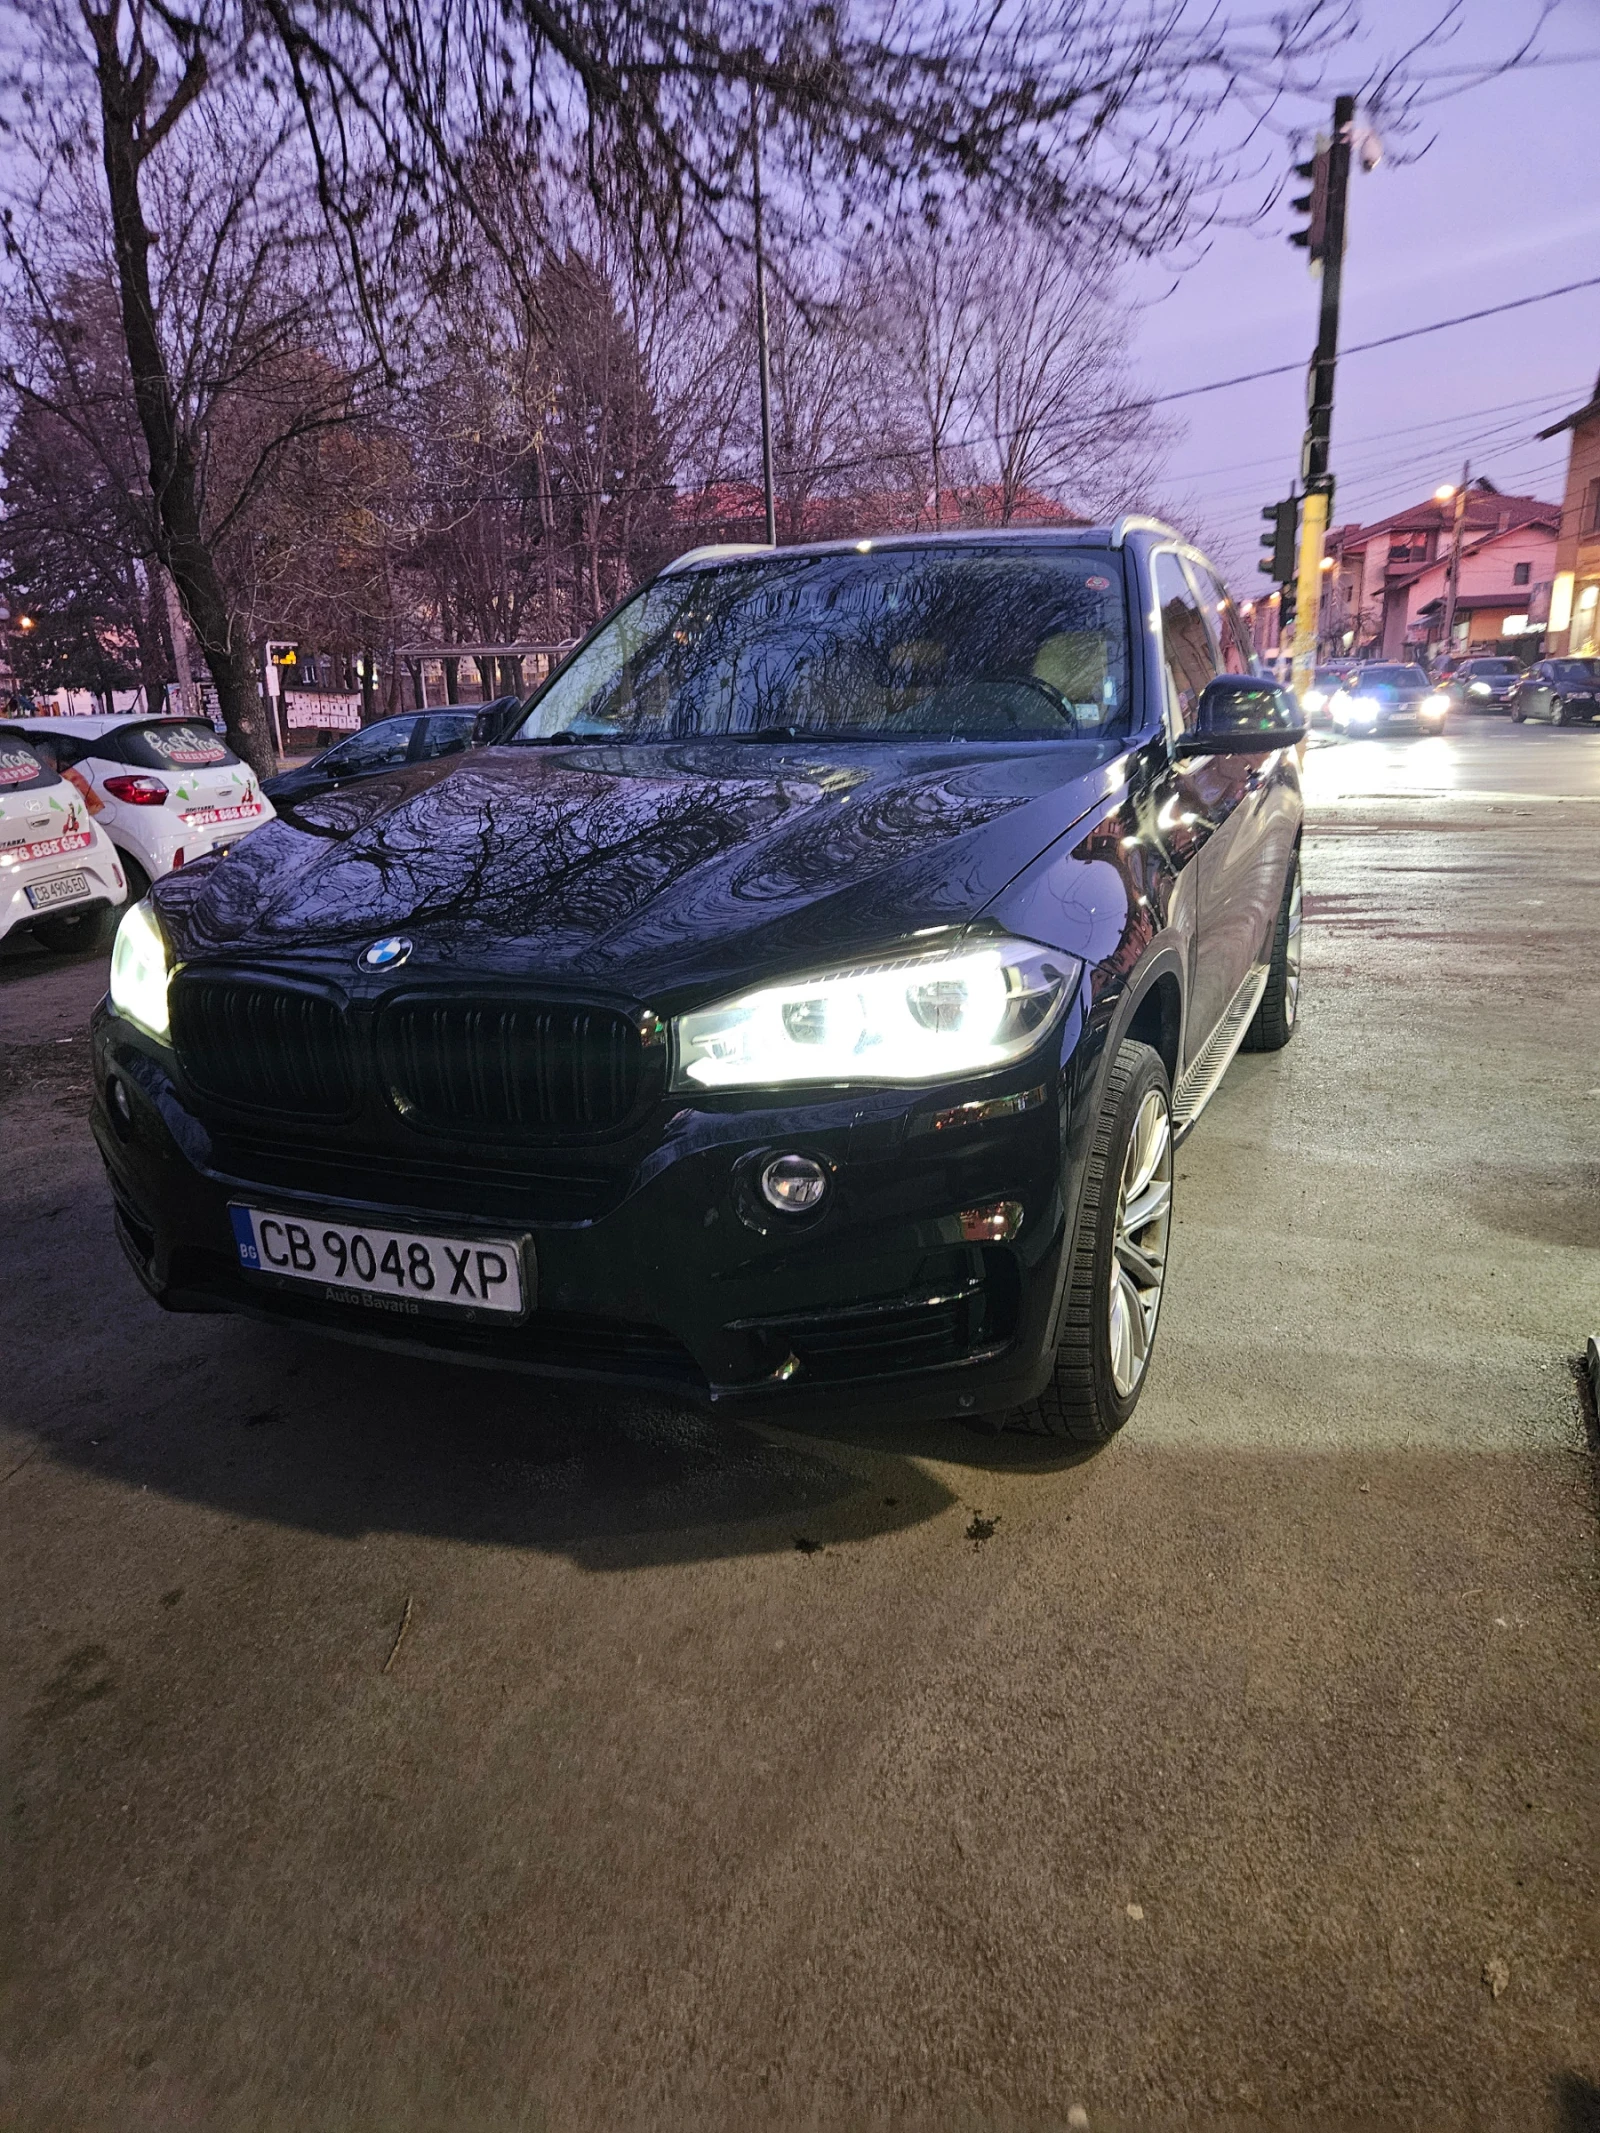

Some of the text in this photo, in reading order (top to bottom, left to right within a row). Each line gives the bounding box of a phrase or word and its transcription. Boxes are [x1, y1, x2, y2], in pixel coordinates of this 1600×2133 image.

[61, 835, 86, 851] 654
[240, 1243, 257, 1260] BG
[259, 1219, 508, 1299] CB 9048 XP
[325, 1287, 419, 1315] Auto Bavaria
